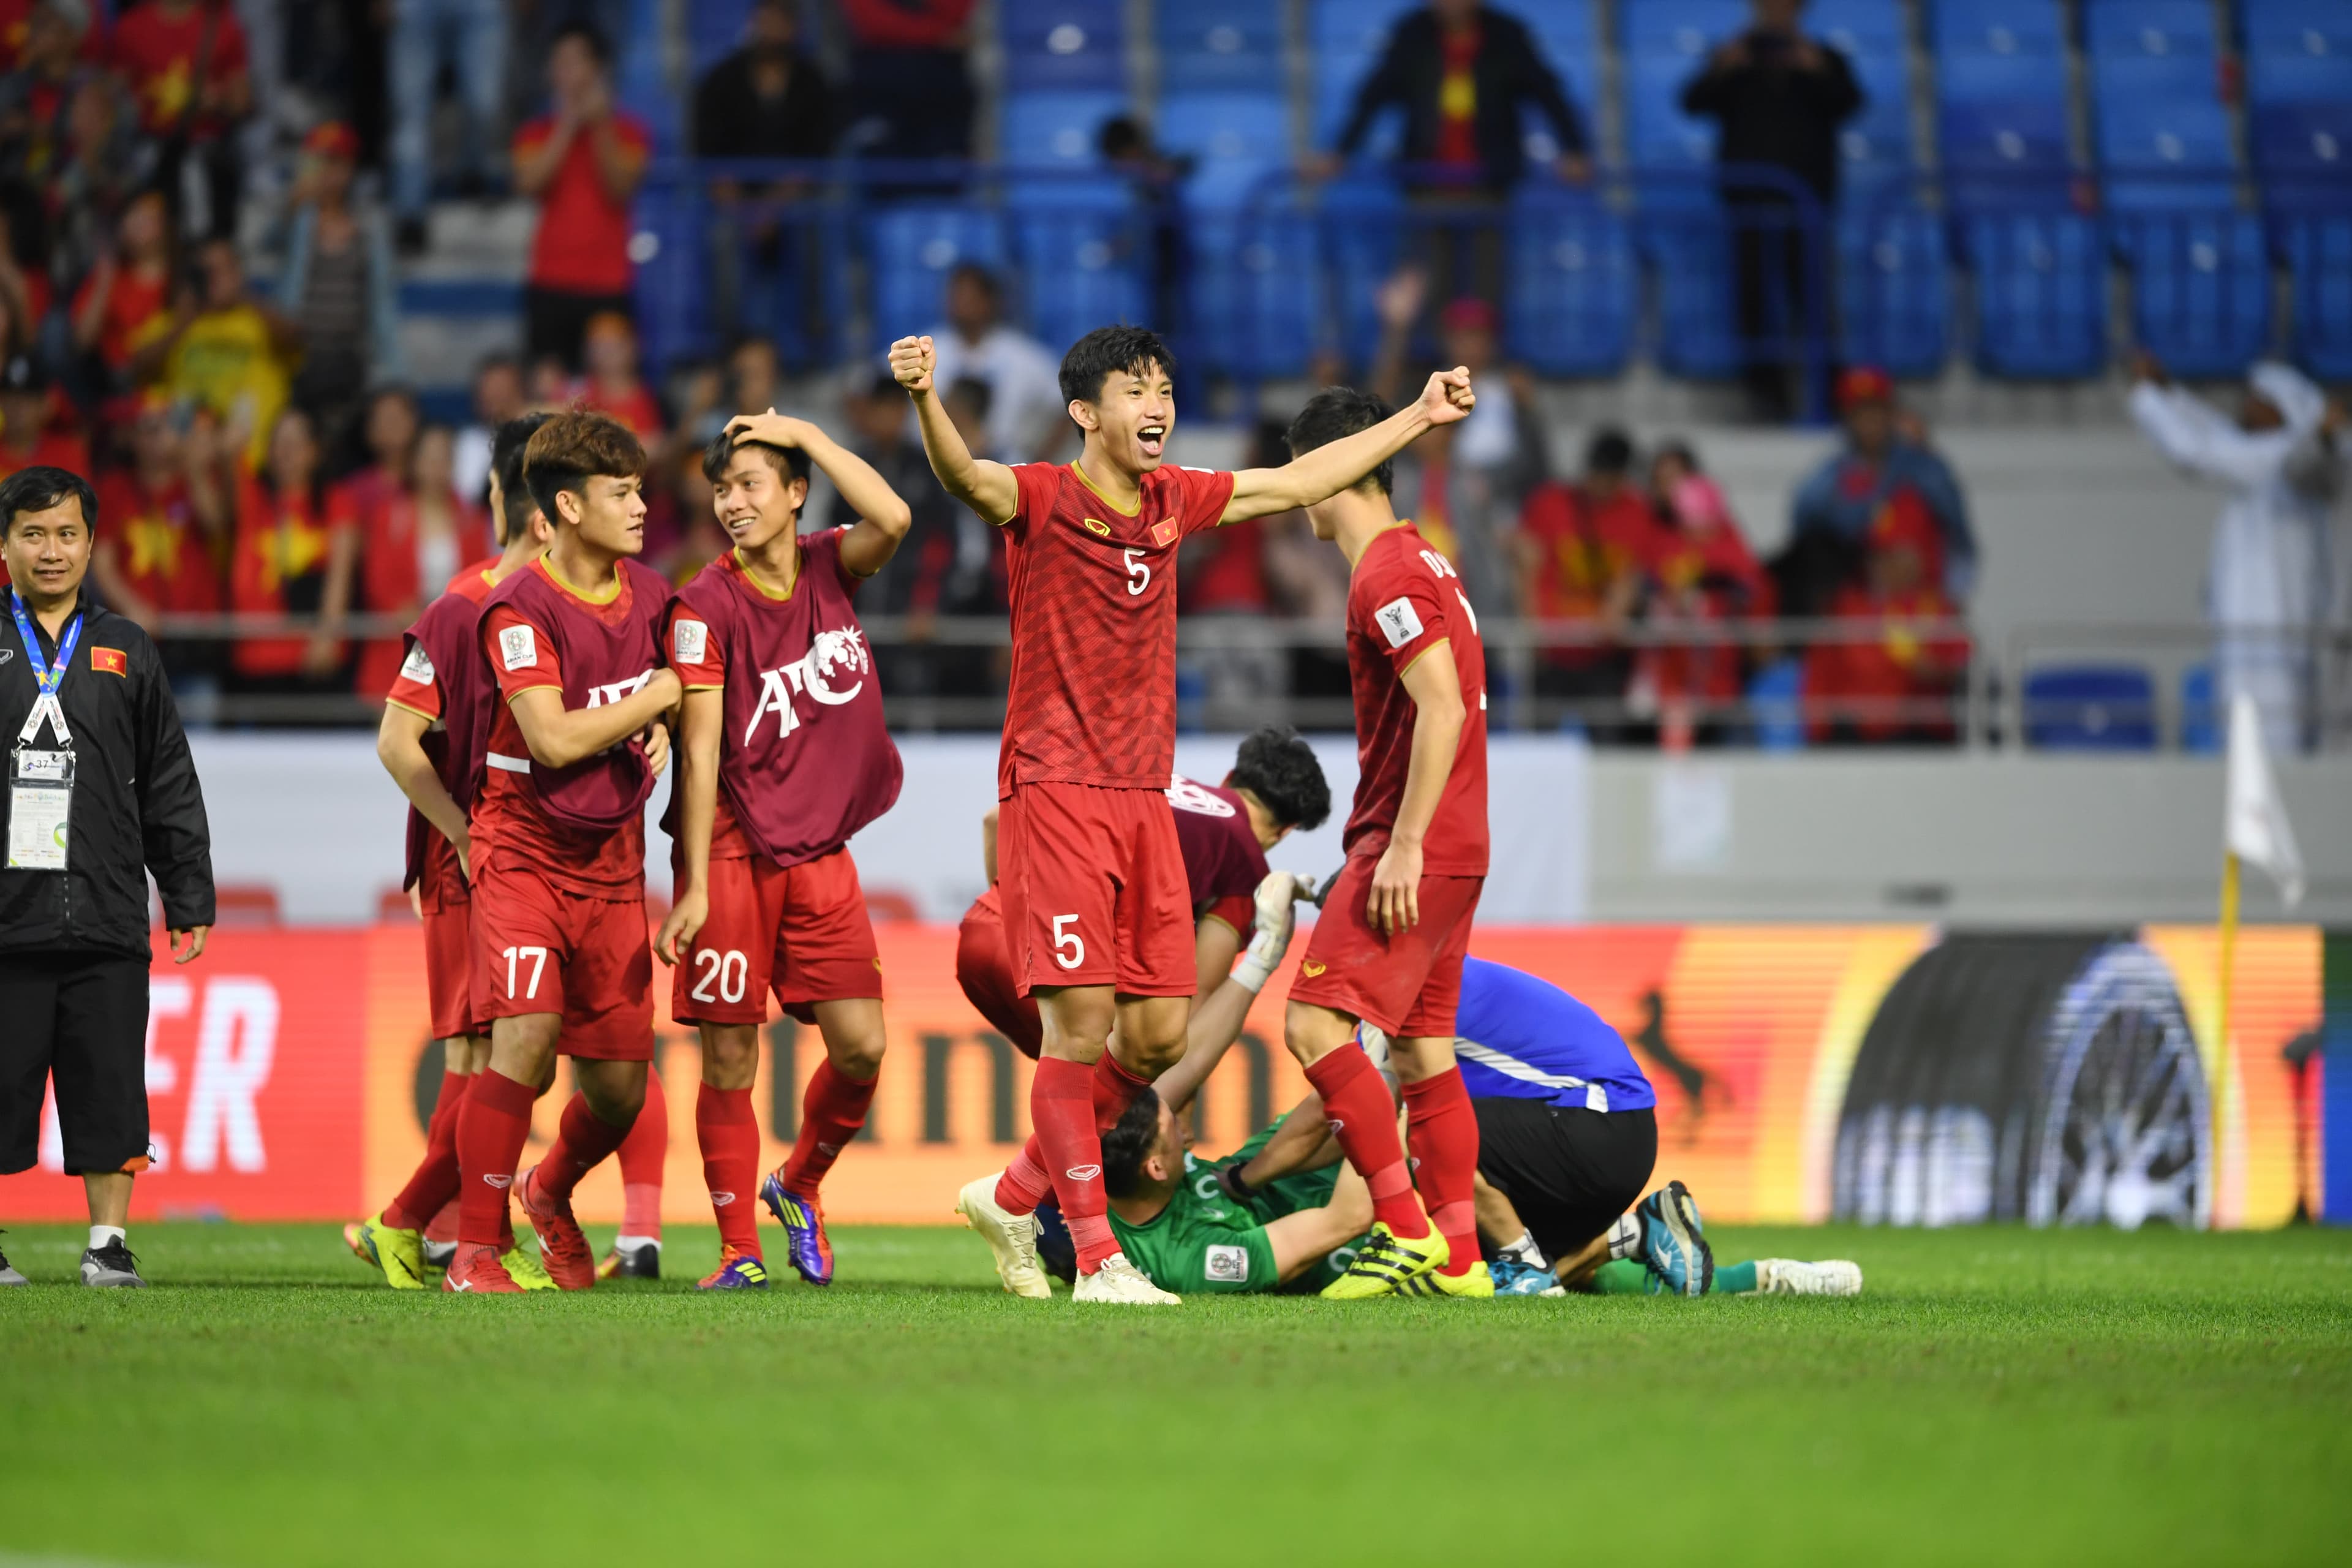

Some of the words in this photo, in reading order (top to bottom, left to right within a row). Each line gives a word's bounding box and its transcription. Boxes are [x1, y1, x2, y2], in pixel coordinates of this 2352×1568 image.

[1123, 547, 1150, 596] 5
[1052, 913, 1085, 969] 5
[503, 946, 548, 1000] 17
[692, 948, 748, 1004] 20
[40, 975, 281, 1173] ER
